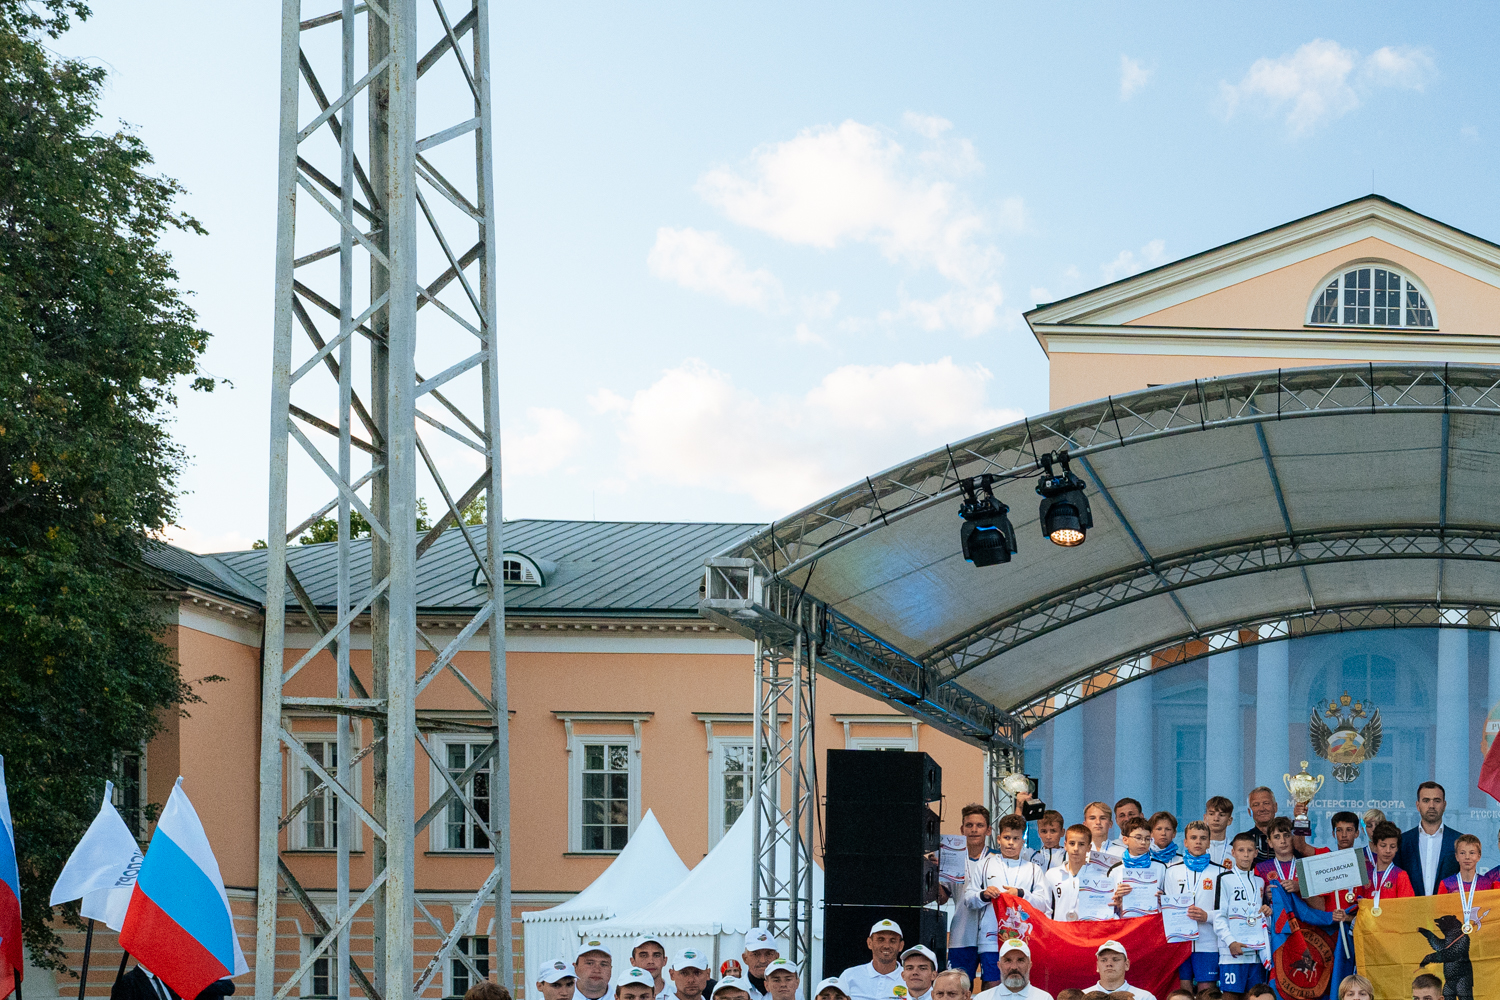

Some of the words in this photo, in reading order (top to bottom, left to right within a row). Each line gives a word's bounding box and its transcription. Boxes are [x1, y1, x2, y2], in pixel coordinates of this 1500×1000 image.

[1286, 799, 1365, 809] МИСТЕРСТВО
[1367, 800, 1406, 809] СПОРТА
[1315, 862, 1354, 876] ЯРОСЛАВСКАЯ
[1324, 873, 1349, 883] ОБЛАСТЬ
[1056, 887, 1062, 898] 9
[1224, 973, 1237, 985] 20
